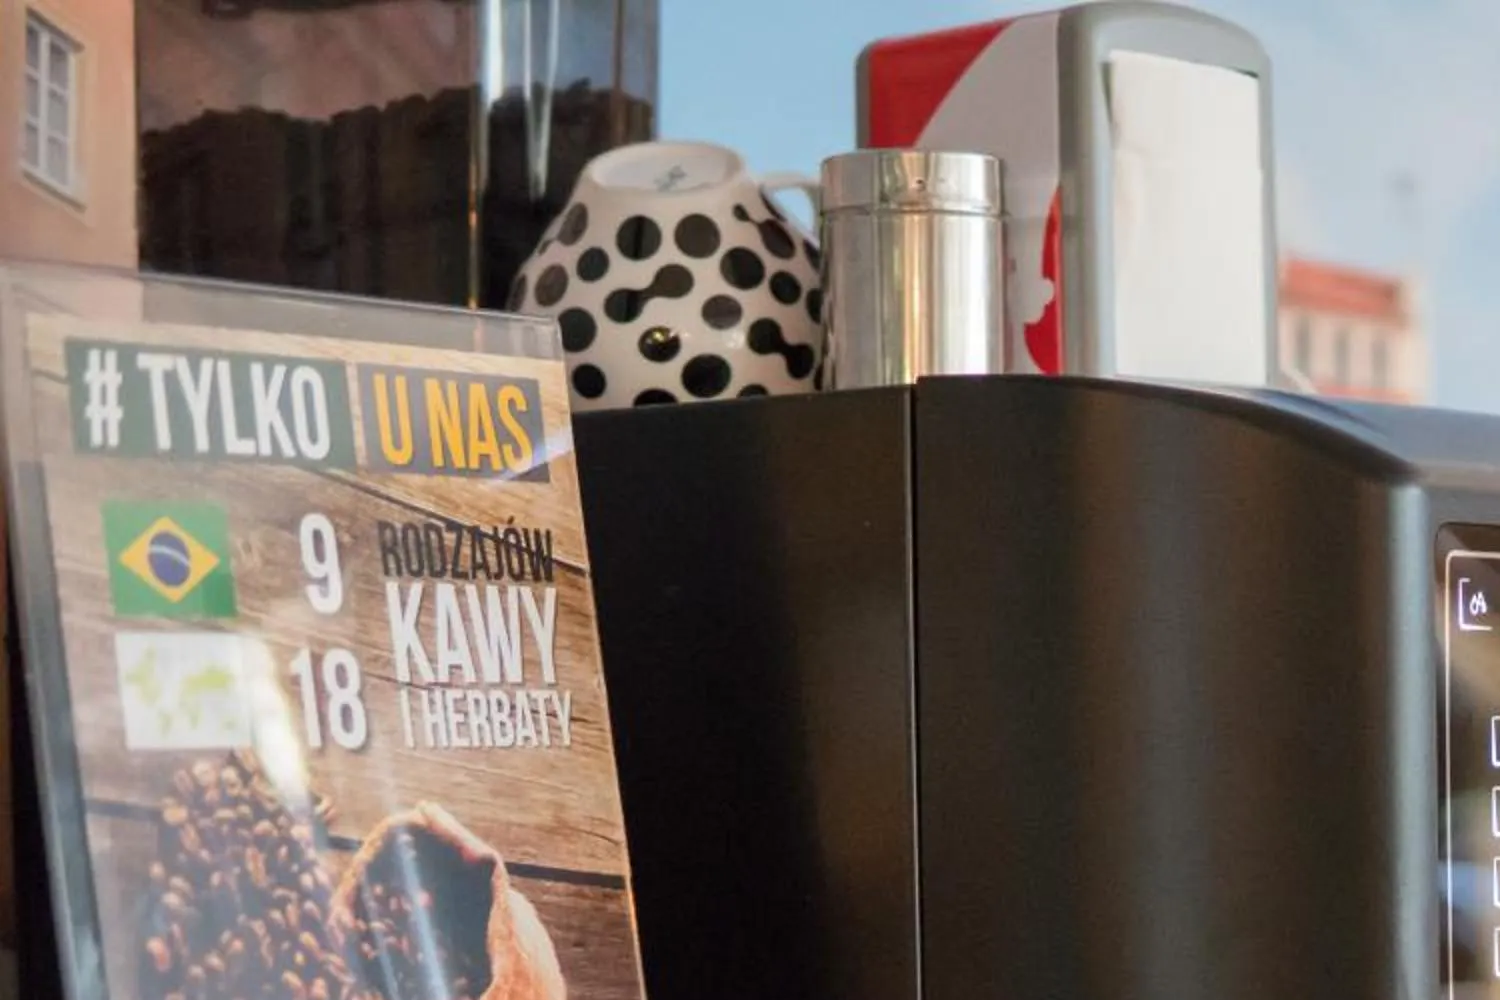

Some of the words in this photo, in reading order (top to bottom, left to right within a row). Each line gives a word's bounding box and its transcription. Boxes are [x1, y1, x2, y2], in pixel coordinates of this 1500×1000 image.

[136, 352, 331, 461] TYLKO
[372, 373, 415, 465] U
[427, 377, 534, 471] NAS
[299, 512, 344, 615] 9
[377, 515, 555, 583] RODZAJÓW
[384, 580, 558, 685] KAWY
[289, 647, 369, 751] 18
[420, 687, 572, 749] HERBATY
